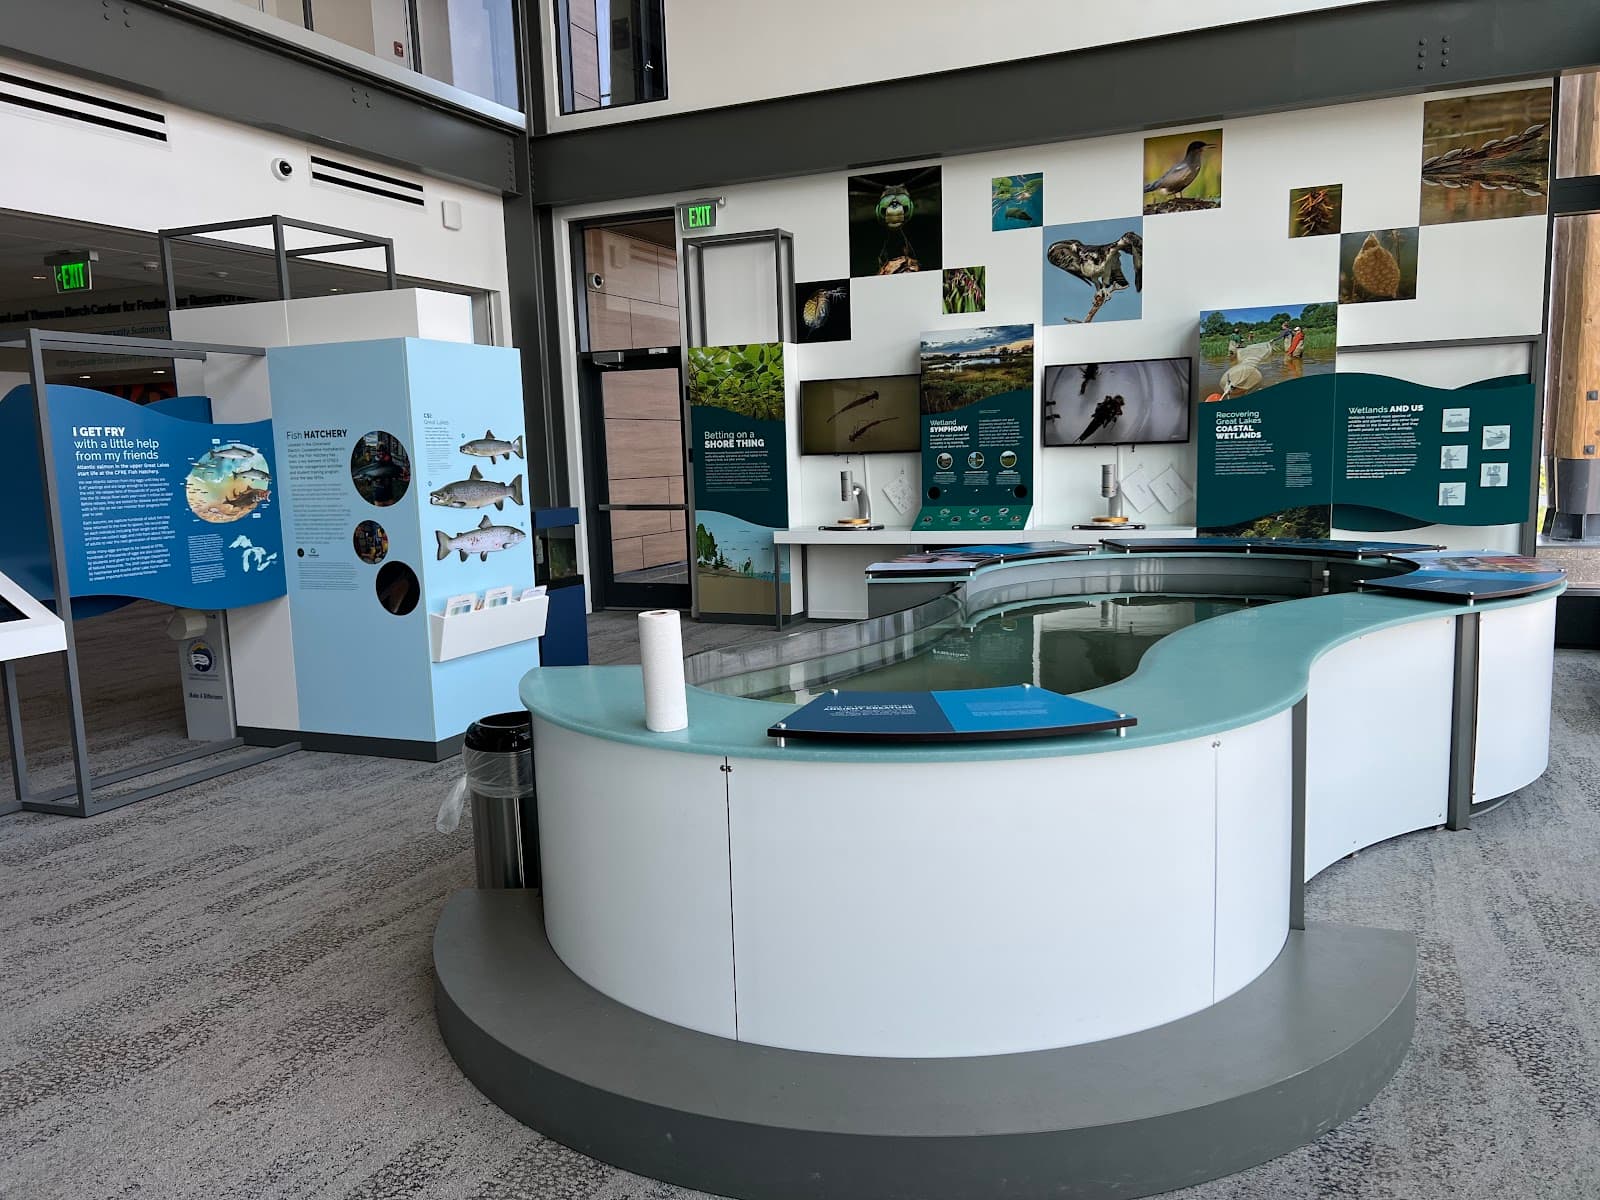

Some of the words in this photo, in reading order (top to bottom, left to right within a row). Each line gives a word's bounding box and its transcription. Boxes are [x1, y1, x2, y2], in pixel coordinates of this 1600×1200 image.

[689, 206, 711, 227] EXIT
[62, 264, 84, 289] EXIT
[1348, 405, 1388, 414] Wetlands
[1389, 405, 1409, 413] AND
[1411, 404, 1424, 412] US
[1216, 410, 1259, 419] Recovering
[930, 418, 957, 426] Wetland
[72, 427, 77, 437] I
[80, 427, 102, 437] GET
[104, 427, 125, 437] FRY
[930, 425, 968, 433] SYMPHONY
[1216, 425, 1254, 433] COASTAL
[286, 431, 302, 440] Fish
[304, 429, 347, 439] HATCHERY
[704, 431, 734, 440] Betting
[1216, 432, 1262, 440] WETLANDS
[74, 439, 98, 449] with
[100, 441, 107, 449] a
[109, 439, 134, 449] little
[136, 439, 159, 450] help
[704, 439, 734, 448] SHORE
[736, 439, 764, 448] THING
[75, 450, 101, 461] from
[104, 452, 120, 462] my
[123, 450, 159, 460] friends
